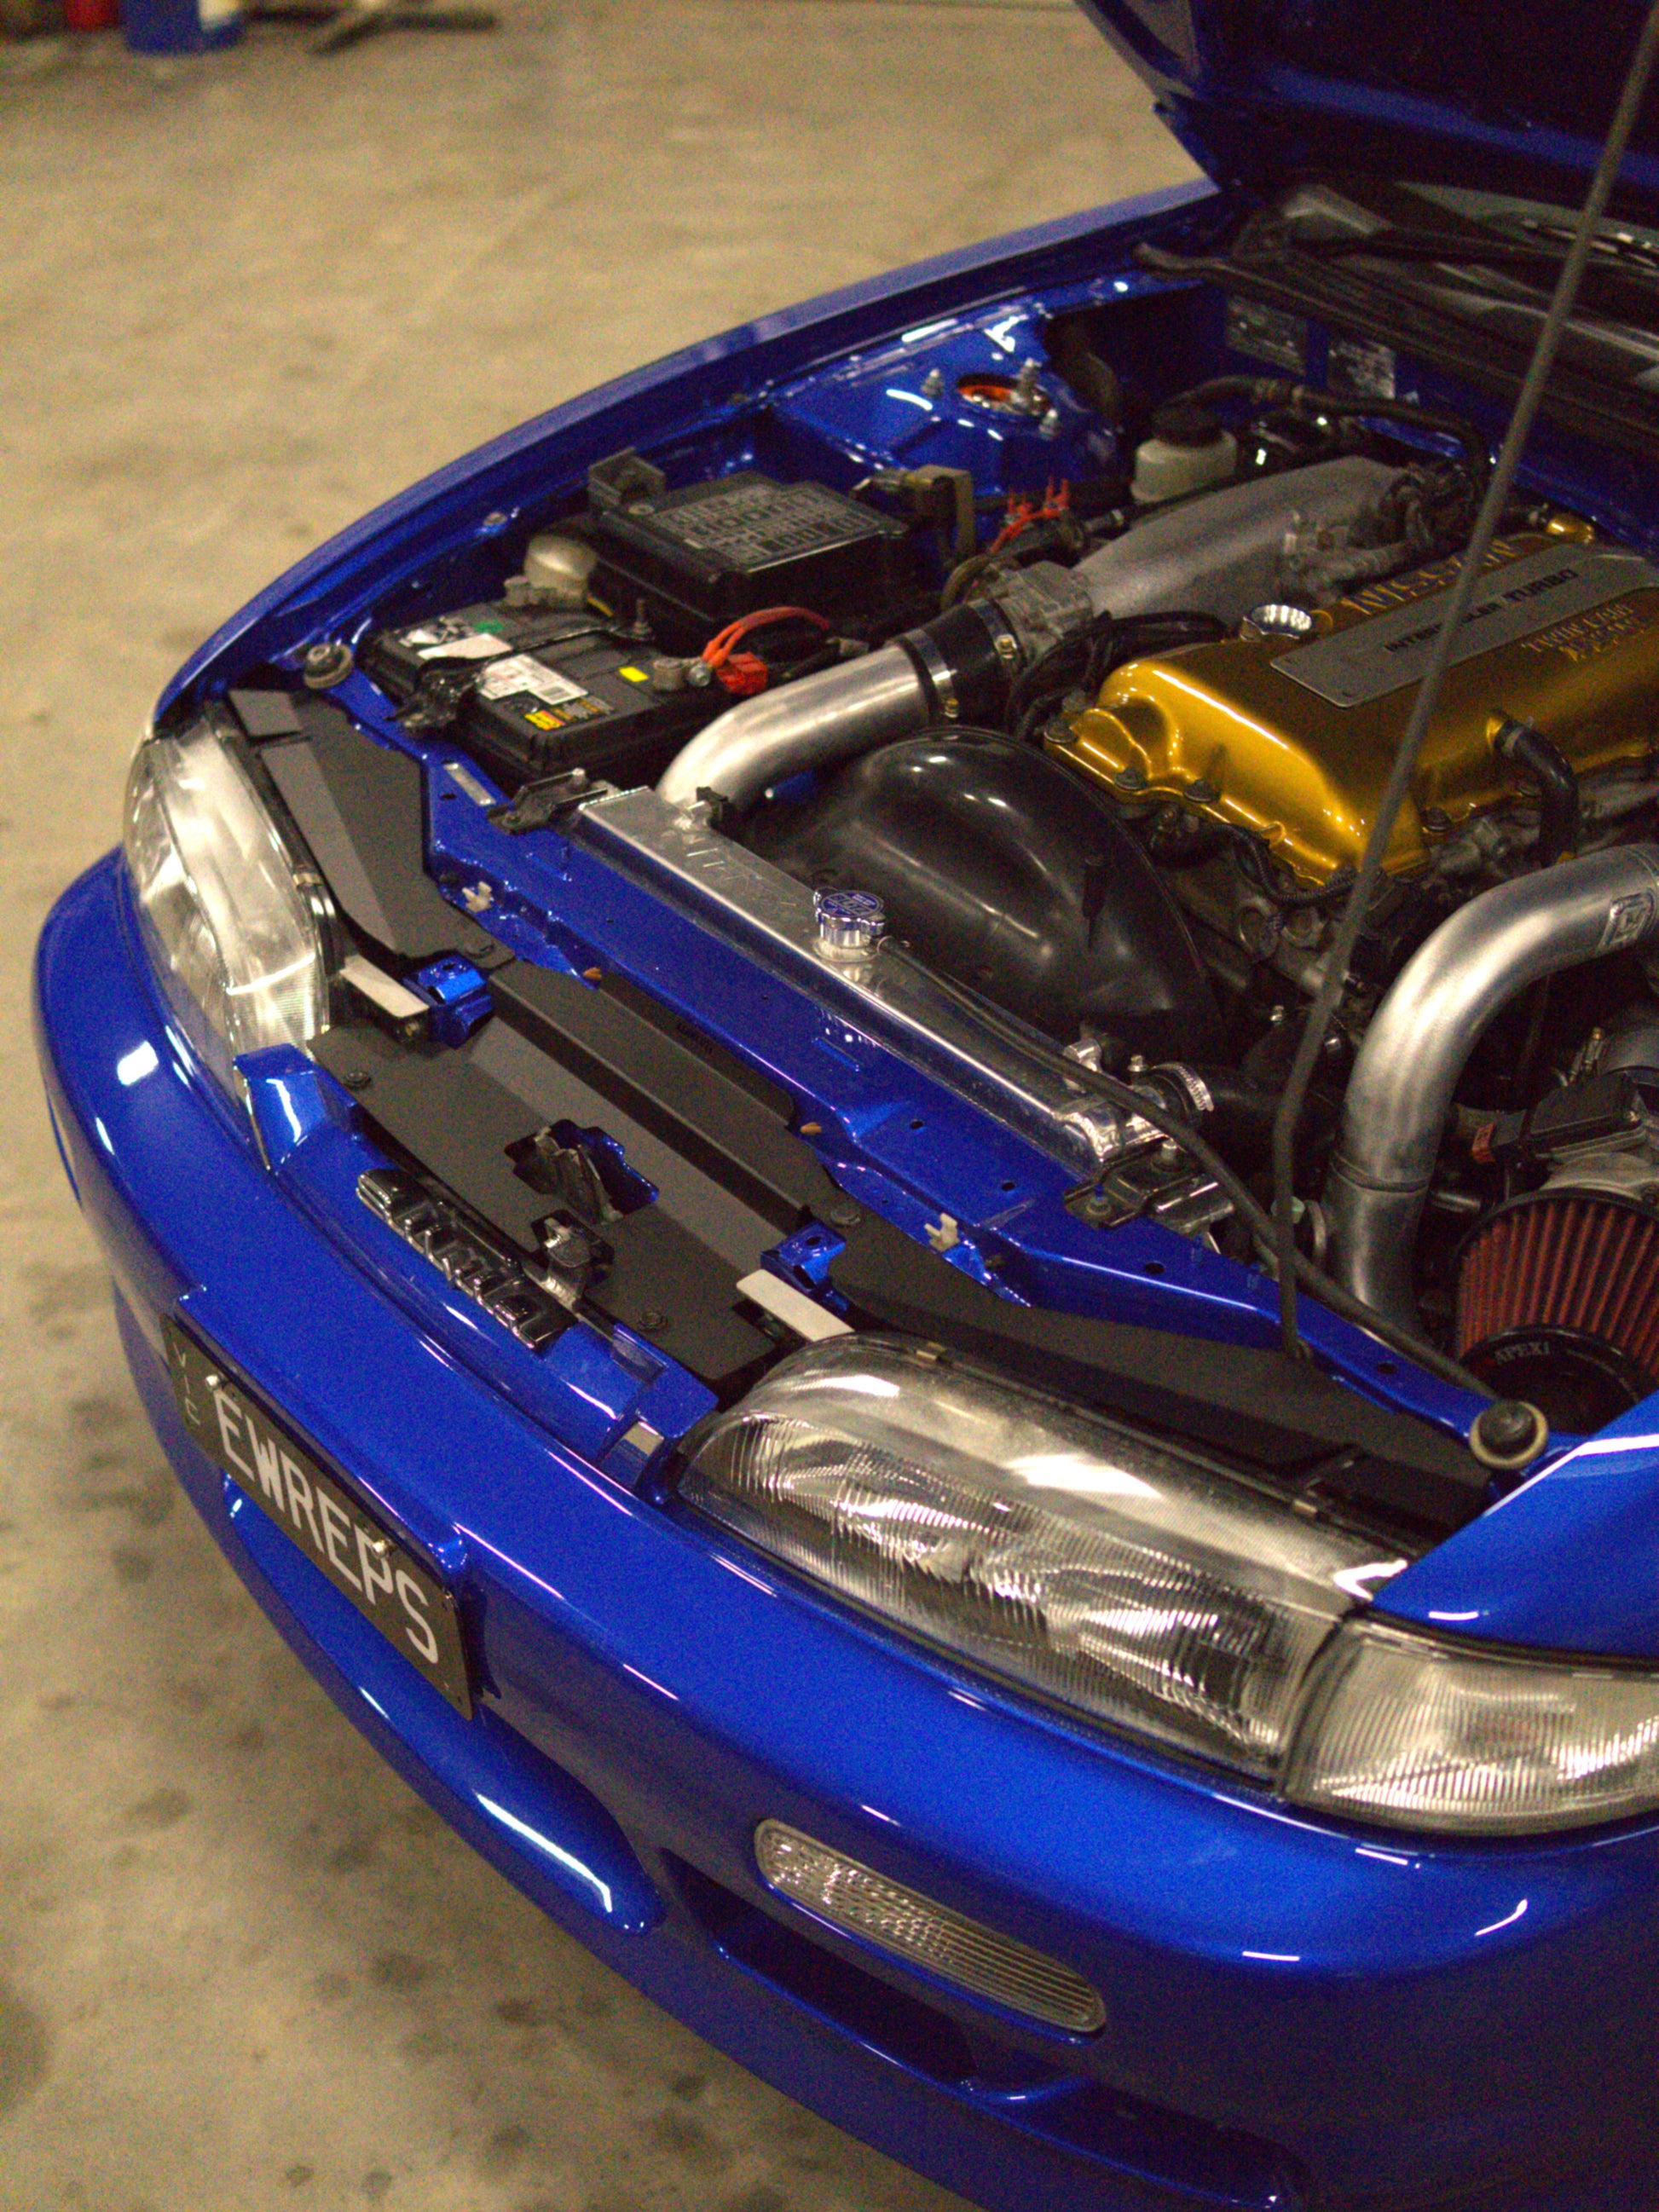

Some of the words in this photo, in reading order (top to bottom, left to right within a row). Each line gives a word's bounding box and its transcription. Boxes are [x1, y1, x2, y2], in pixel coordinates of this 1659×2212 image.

[1501, 569, 1578, 602] TURBO
[173, 1341, 200, 1425] VIC
[214, 1390, 438, 1663] EWREPS
